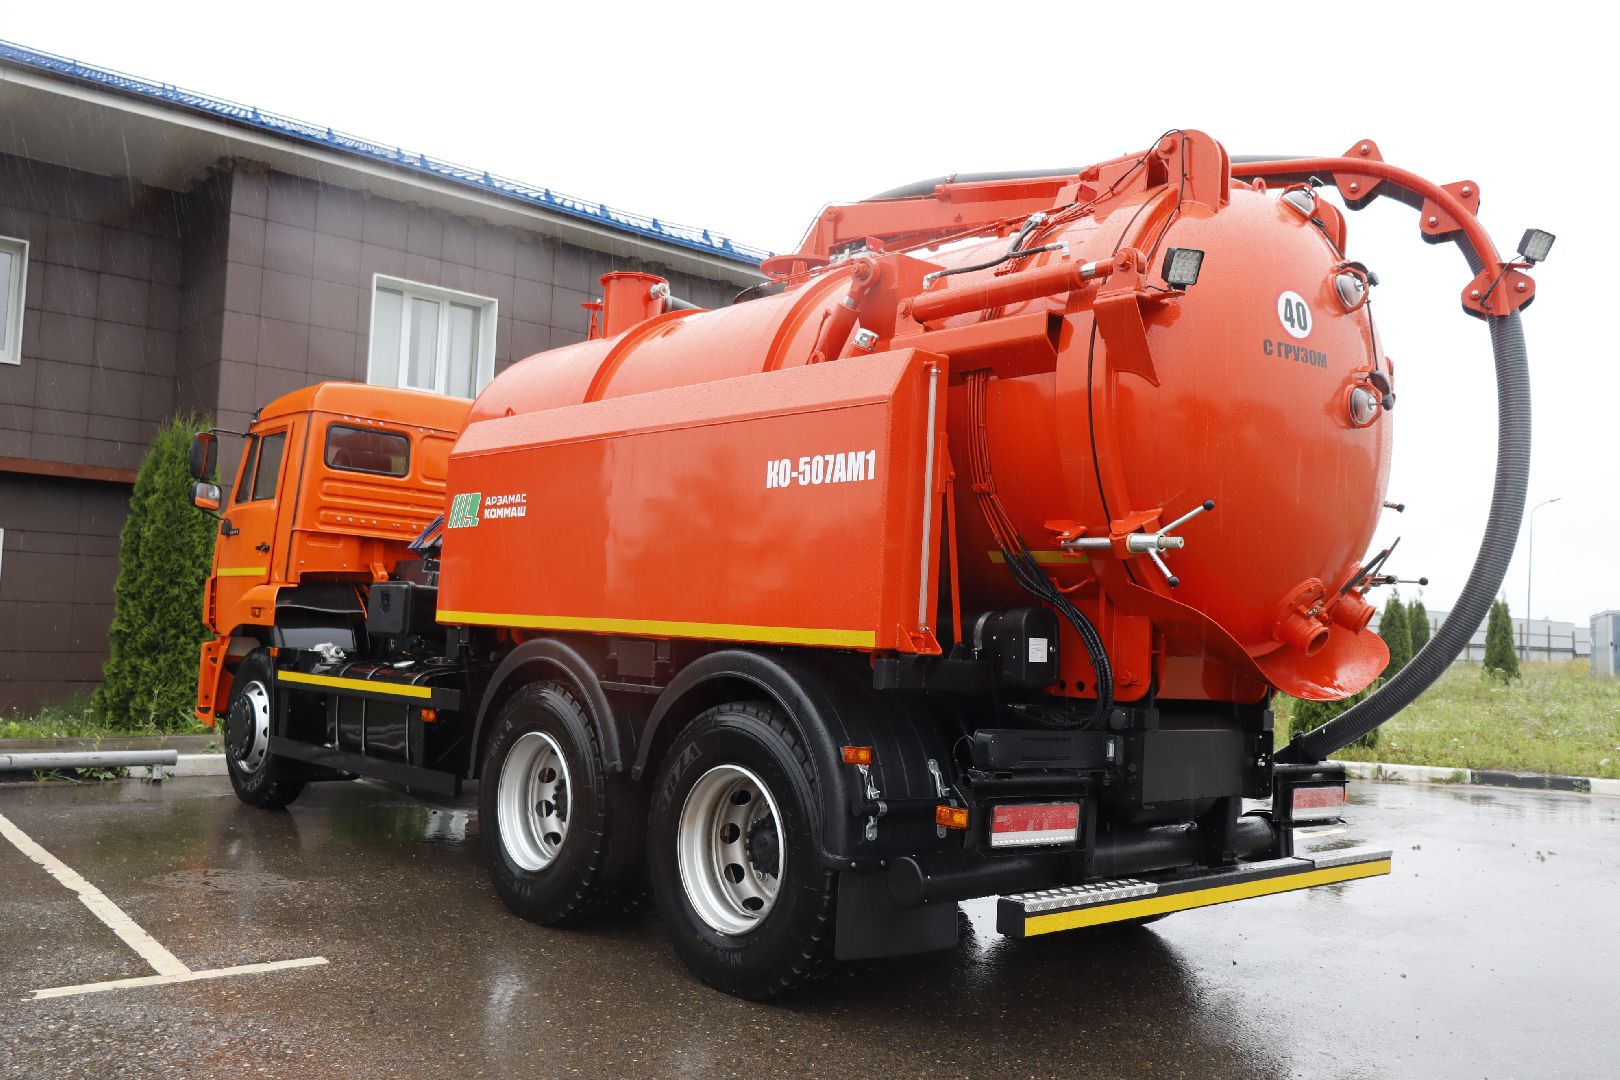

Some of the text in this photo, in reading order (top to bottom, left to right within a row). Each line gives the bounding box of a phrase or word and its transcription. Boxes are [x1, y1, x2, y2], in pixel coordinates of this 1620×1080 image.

[1284, 298, 1307, 331] 40
[1263, 339, 1327, 368] С ГРУЗОМ
[766, 449, 876, 489] КО-507АМ1
[484, 505, 527, 519] КОММАШ
[485, 493, 527, 507] АРЗАМАС
